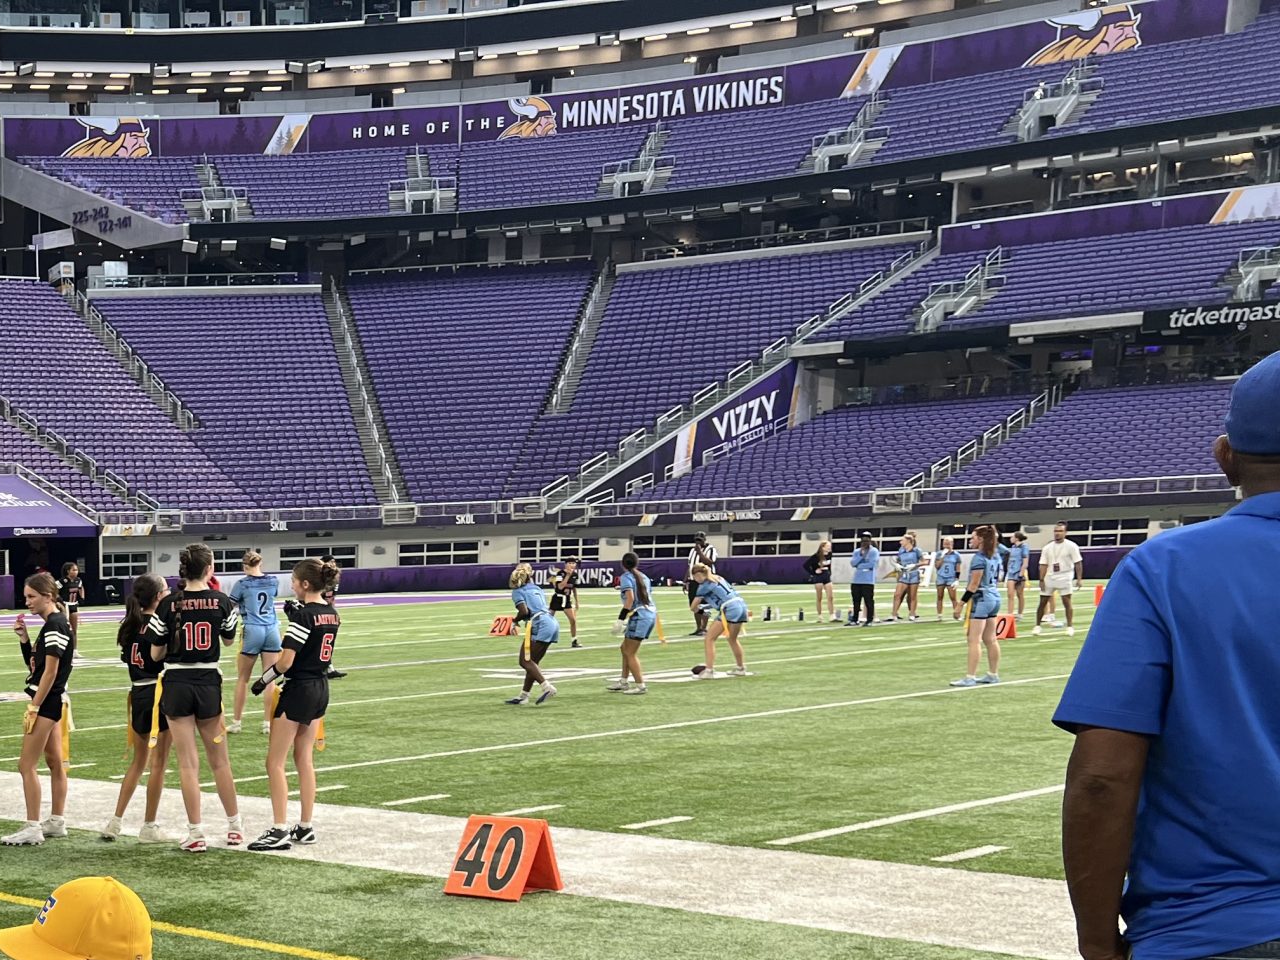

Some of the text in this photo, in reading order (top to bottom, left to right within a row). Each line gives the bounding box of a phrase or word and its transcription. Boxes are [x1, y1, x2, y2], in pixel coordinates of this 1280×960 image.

[562, 75, 784, 129] MINNESOTA VIKINGS
[352, 115, 505, 139] HOME OF THE
[712, 389, 779, 441] VIZZY
[1055, 496, 1081, 509] SKOL
[270, 521, 289, 532] SKOL
[455, 514, 476, 525] SKOL
[257, 591, 269, 616] 2
[182, 621, 213, 651] 10
[490, 617, 508, 634] 20
[130, 642, 145, 669] 4
[320, 633, 335, 662] 6
[454, 823, 525, 892] 40
